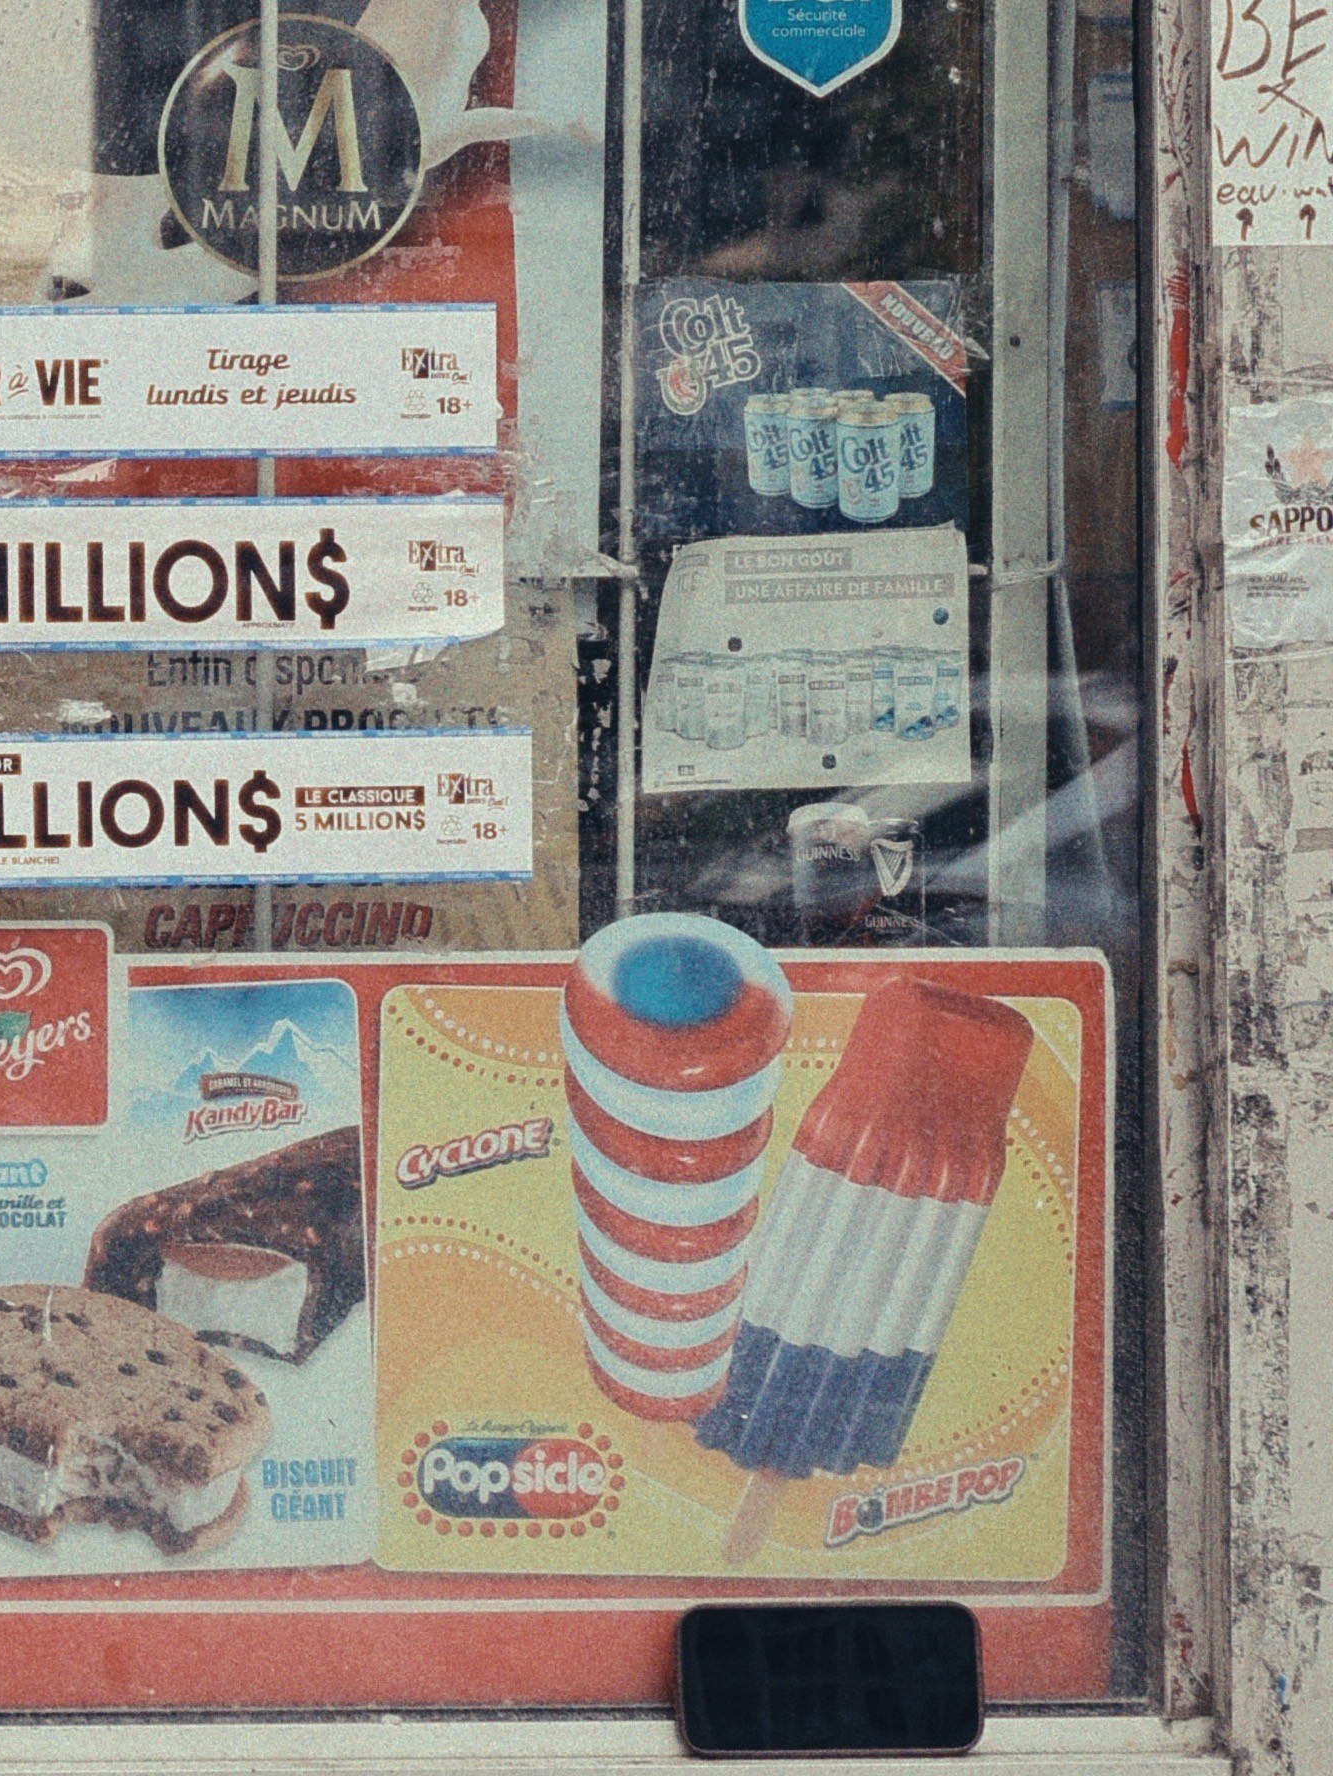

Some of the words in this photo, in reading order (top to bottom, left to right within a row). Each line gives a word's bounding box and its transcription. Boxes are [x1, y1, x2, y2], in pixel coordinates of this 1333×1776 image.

[787, 7, 848, 22] Sécurité
[771, 24, 867, 38] commerciale
[659, 293, 751, 359] Colt
[878, 291, 957, 362] NOUVEAU
[206, 348, 292, 377] Tirage
[400, 347, 460, 380] Extra
[700, 334, 762, 389] 45
[7, 364, 30, 399] à
[146, 384, 230, 406] lundis
[240, 387, 267, 405] et
[273, 383, 357, 411] jeudis
[436, 396, 474, 415] 18+
[789, 427, 833, 463] Colt
[839, 434, 889, 474] Colt
[808, 453, 836, 481] 45
[863, 464, 895, 494] 45
[407, 538, 466, 572] Extra
[734, 555, 755, 569] LE
[756, 554, 793, 568] BON
[797, 550, 846, 567] GOÛT
[442, 588, 480, 607] 18+
[736, 583, 771, 600] UNE
[774, 581, 844, 598] AFFAIRE
[848, 581, 871, 595] DE
[874, 578, 946, 594] FAMILLE
[304, 790, 322, 804] LE
[327, 789, 416, 805] CLASSIQUE
[437, 773, 495, 805] Extra
[295, 812, 308, 832] 5
[314, 809, 427, 833] MILLION$
[471, 822, 509, 840] 18+
[796, 844, 861, 863] GUINNESS
[183, 1097, 305, 1141] KandyBar
[45, 1194, 66, 1211] et
[261, 1459, 358, 1490] BISCUIT
[423, 1448, 606, 1498] Popsicle
[270, 1491, 347, 1523] GÉANT
[829, 1480, 949, 1543] BOMBE
[952, 1458, 1025, 1507] POP
